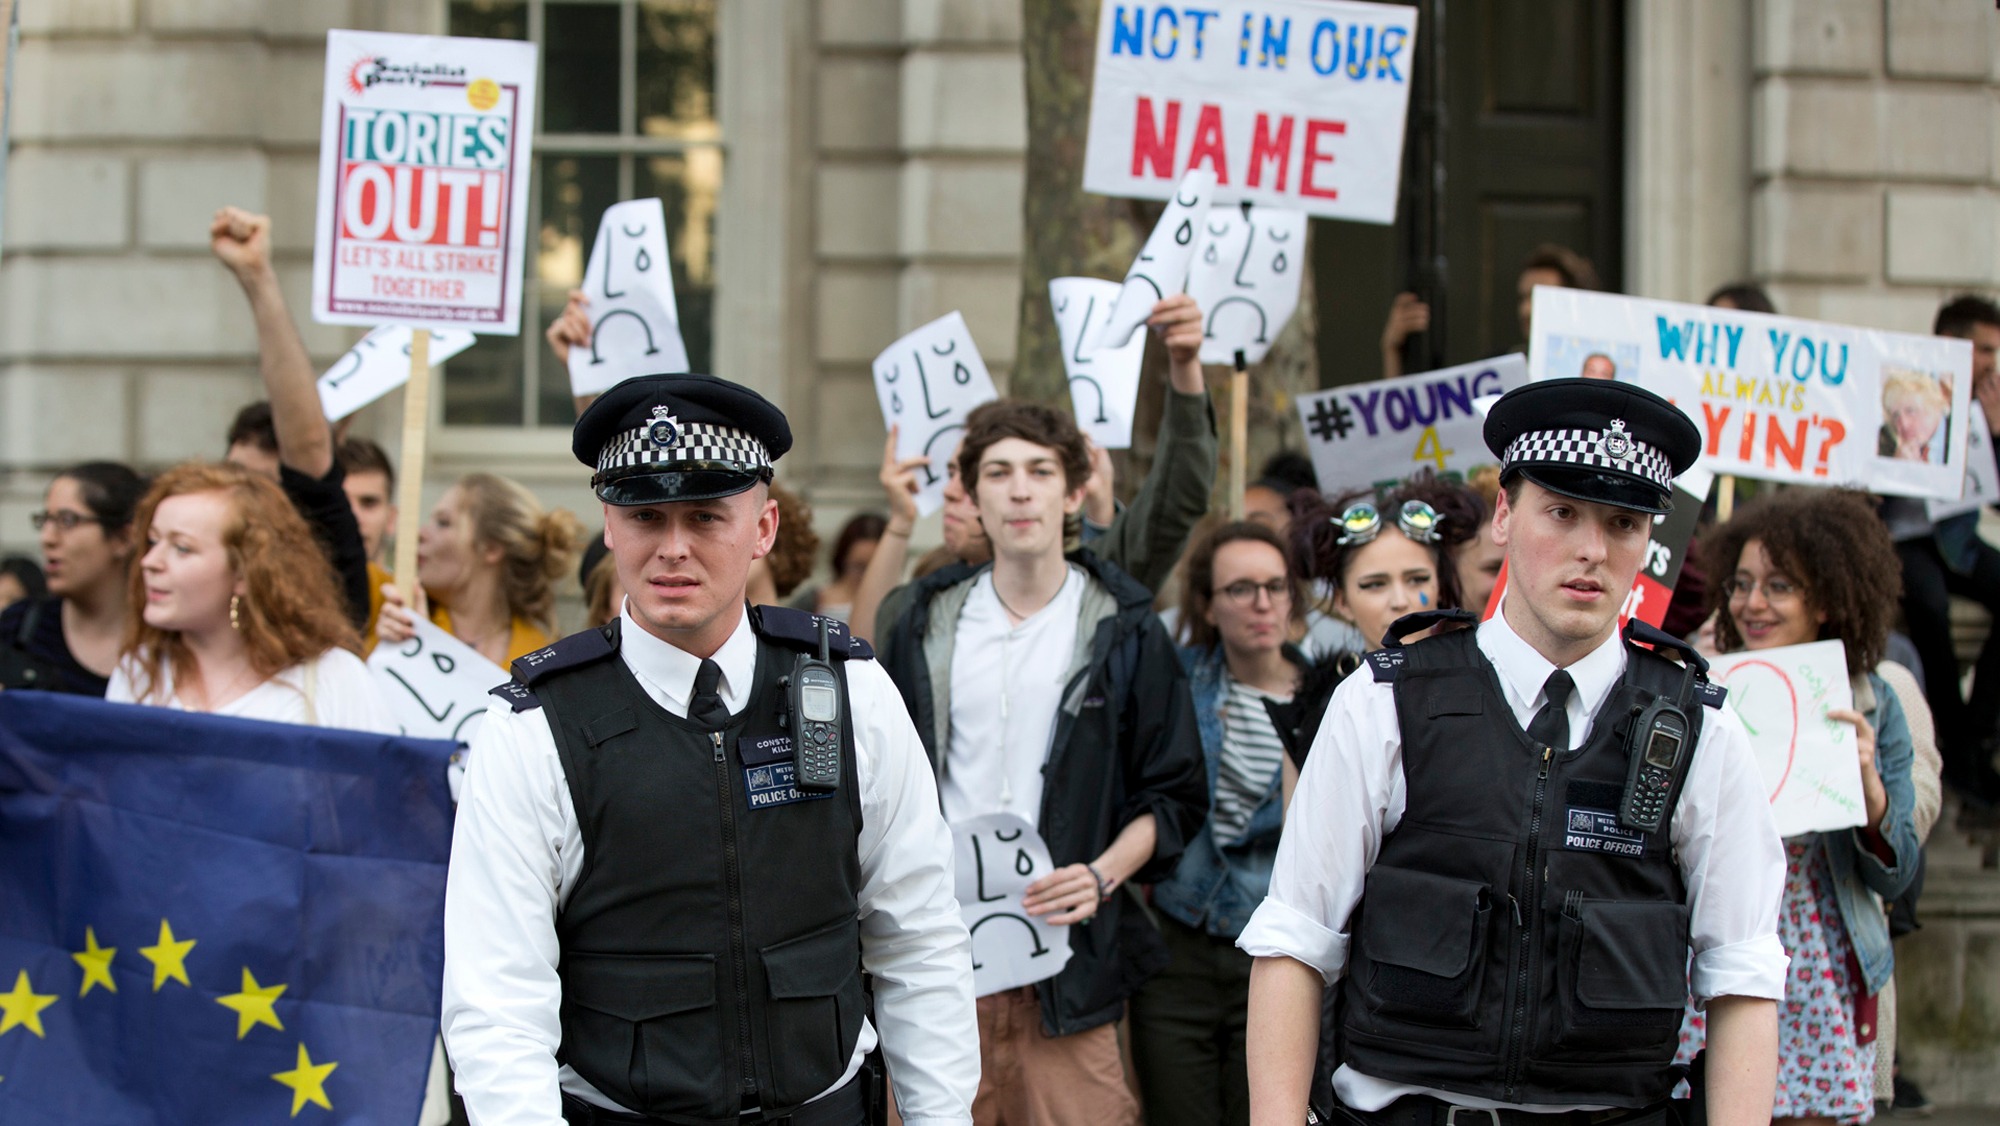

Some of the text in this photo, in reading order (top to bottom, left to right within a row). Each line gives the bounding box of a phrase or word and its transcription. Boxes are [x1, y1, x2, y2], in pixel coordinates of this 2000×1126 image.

[1110, 4, 1408, 83] NOT IN OUR
[373, 57, 466, 76] Socialist
[346, 110, 507, 168] TORIES
[1130, 95, 1347, 201] NAME
[345, 163, 501, 247] OUT!
[341, 246, 498, 274] LET'S ALL STRIKE
[372, 274, 466, 300] TOGETHER
[1655, 314, 1848, 386] WHY YOU
[1307, 369, 1503, 442] #YOUNG
[1701, 371, 1806, 412] ALWAYS
[1413, 425, 1454, 471] 4
[1668, 398, 1846, 477] YIN'?
[1390, 652, 1404, 665] YE
[756, 737, 792, 749] CONSTA
[771, 745, 792, 754] KILL
[751, 790, 788, 806] POLICE
[1566, 835, 1643, 856] POLICE OFFICER
[1603, 826, 1634, 836] POLICE
